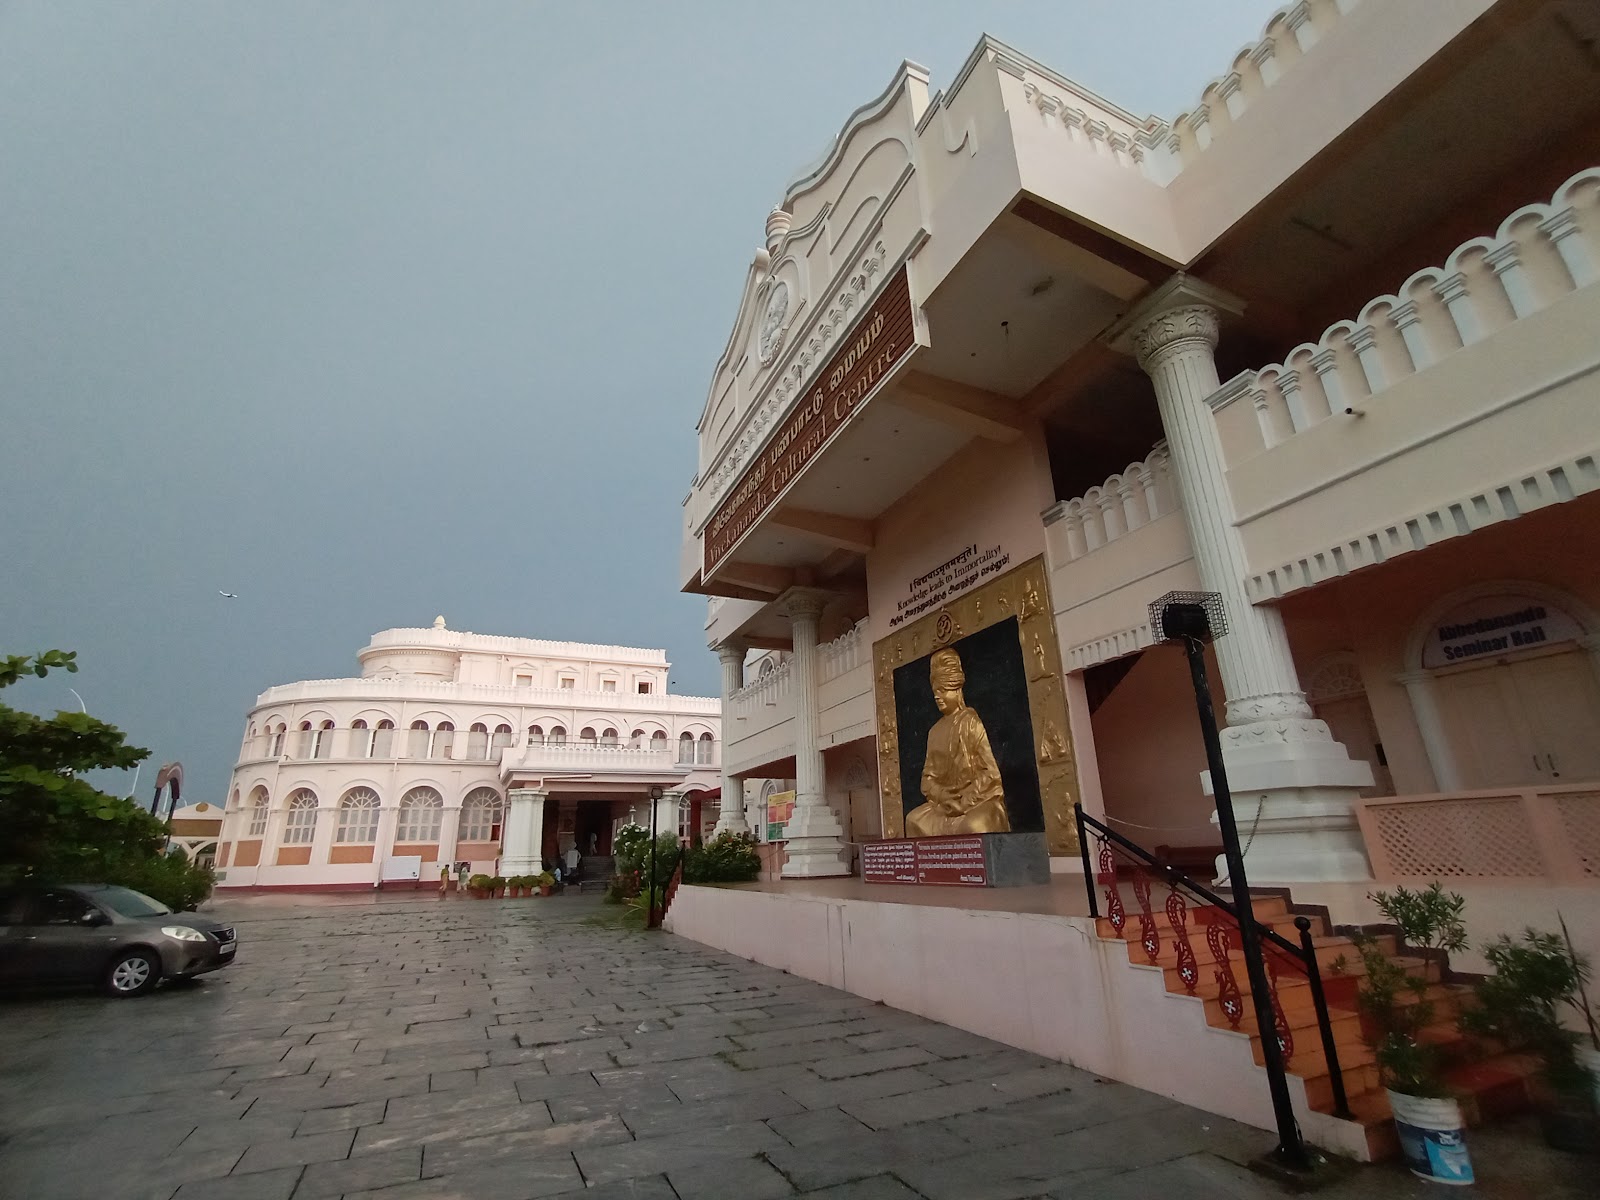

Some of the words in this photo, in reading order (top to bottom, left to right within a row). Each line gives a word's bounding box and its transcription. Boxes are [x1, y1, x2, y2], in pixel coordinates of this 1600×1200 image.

[830, 311, 885, 389] மையம்
[709, 493, 768, 563] Vivekananda
[772, 415, 827, 493] Cultural
[833, 342, 896, 421] Centre
[897, 586, 929, 612] Knowledge
[929, 578, 945, 596] leads
[945, 574, 953, 585] to
[954, 545, 1002, 579] Immortality!
[1443, 636, 1508, 660] Seminar
[1510, 626, 1547, 647] Hall
